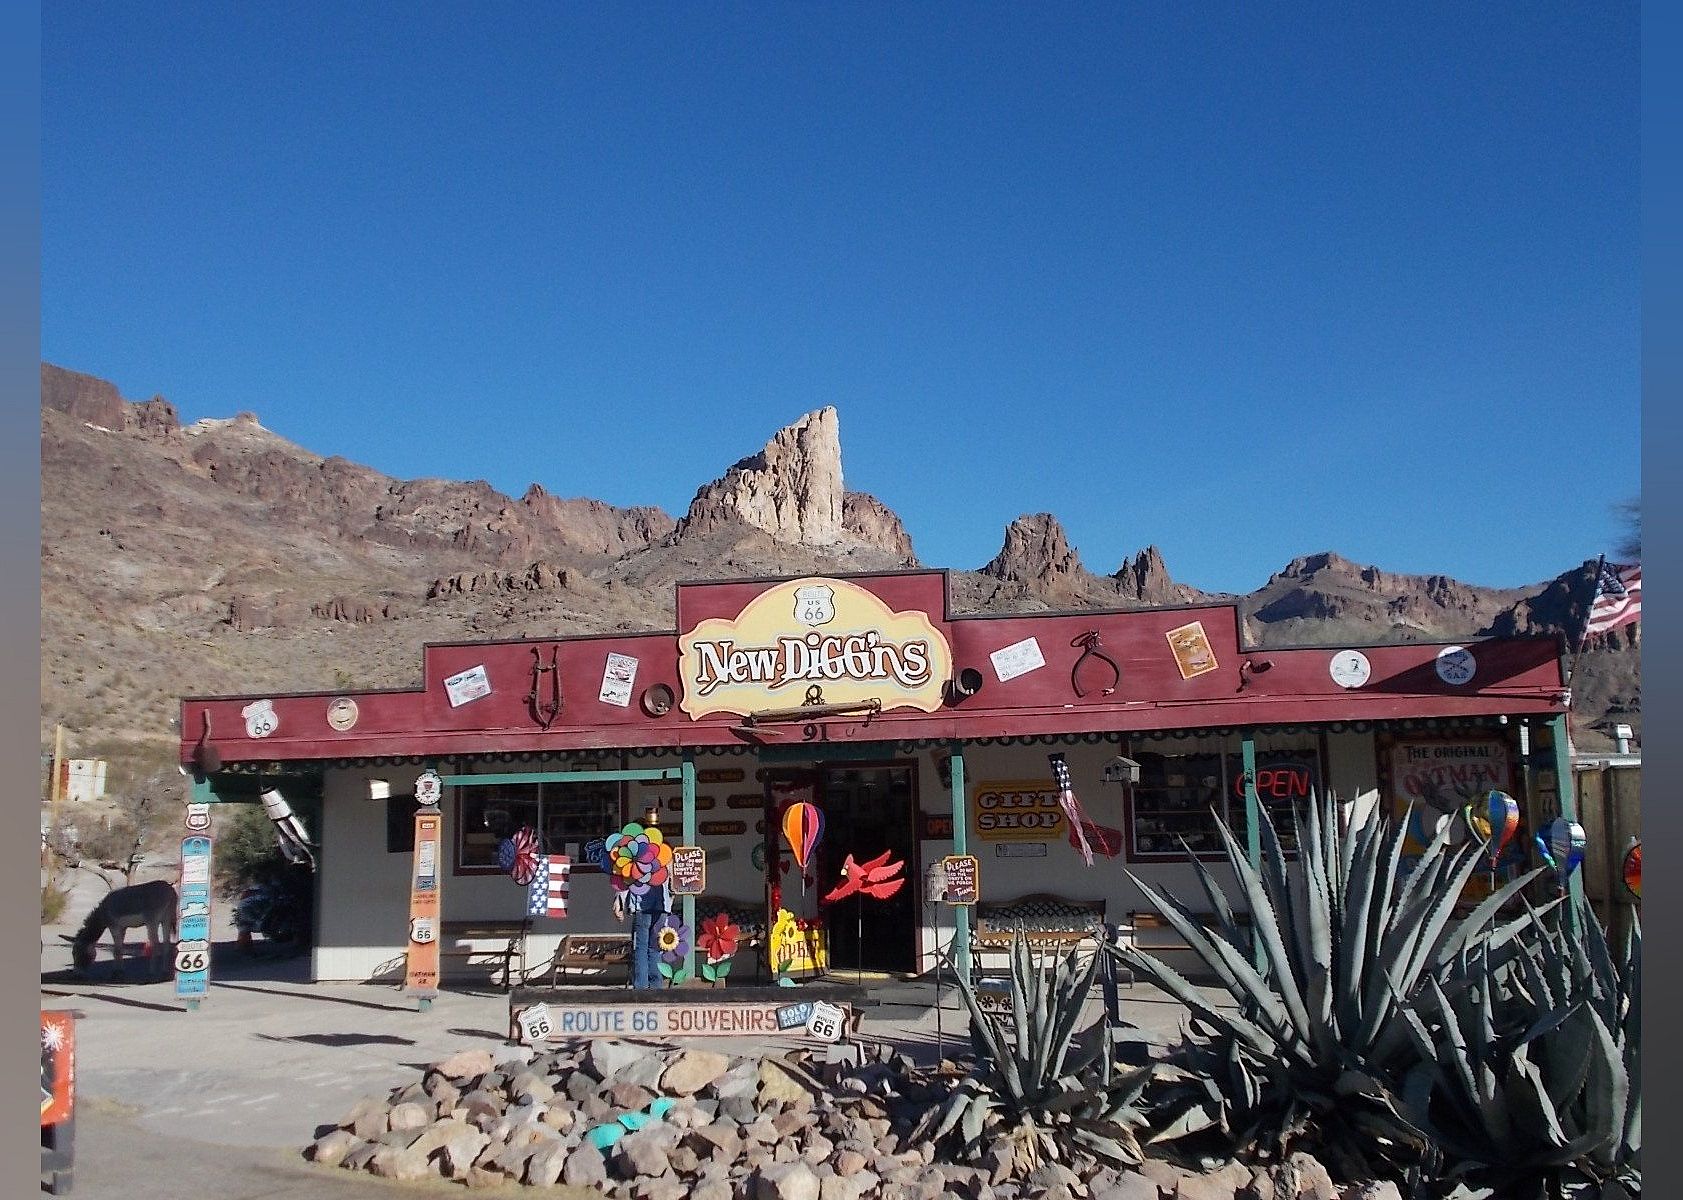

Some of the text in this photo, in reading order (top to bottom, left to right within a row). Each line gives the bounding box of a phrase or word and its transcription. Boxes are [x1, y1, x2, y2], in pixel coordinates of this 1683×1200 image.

[804, 607, 824, 620] 66
[694, 640, 779, 697] New
[803, 723, 830, 742] 91
[1404, 745, 1490, 763] THE ORIGINAL
[978, 789, 1060, 809] GIFT
[978, 811, 1061, 830] SHOP
[675, 850, 701, 862] PLEASE
[947, 860, 972, 871] PLEASE
[416, 930, 431, 939] 66
[180, 953, 204, 970] 66
[562, 1009, 778, 1032] ROUTE 66 SOUVENIRS
[813, 1020, 835, 1037] 66
[529, 1021, 550, 1038] 66
